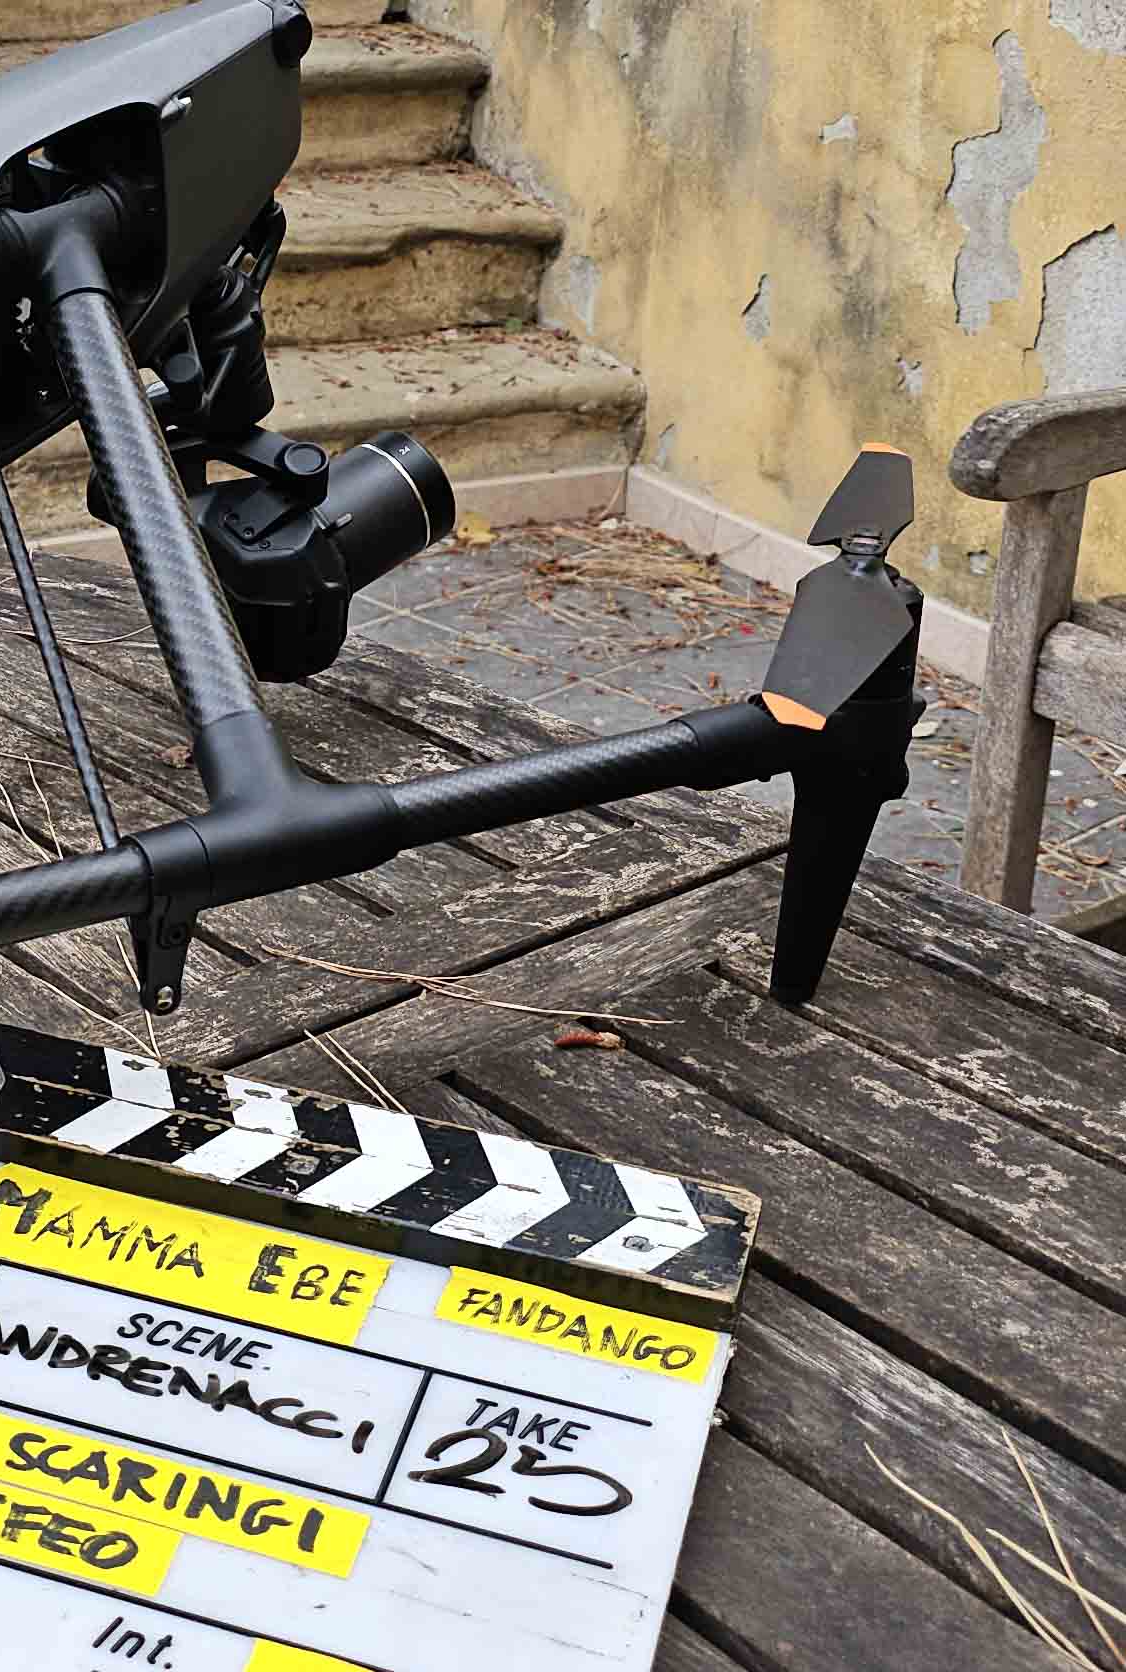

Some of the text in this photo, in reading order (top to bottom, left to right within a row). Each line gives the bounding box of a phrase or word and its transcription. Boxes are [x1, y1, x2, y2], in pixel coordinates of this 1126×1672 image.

[457, 1287, 697, 1370] FANDANGO
[465, 1397, 592, 1452] TAKE
[408, 1427, 634, 1517] 25
[92, 1615, 173, 1670] Int.
